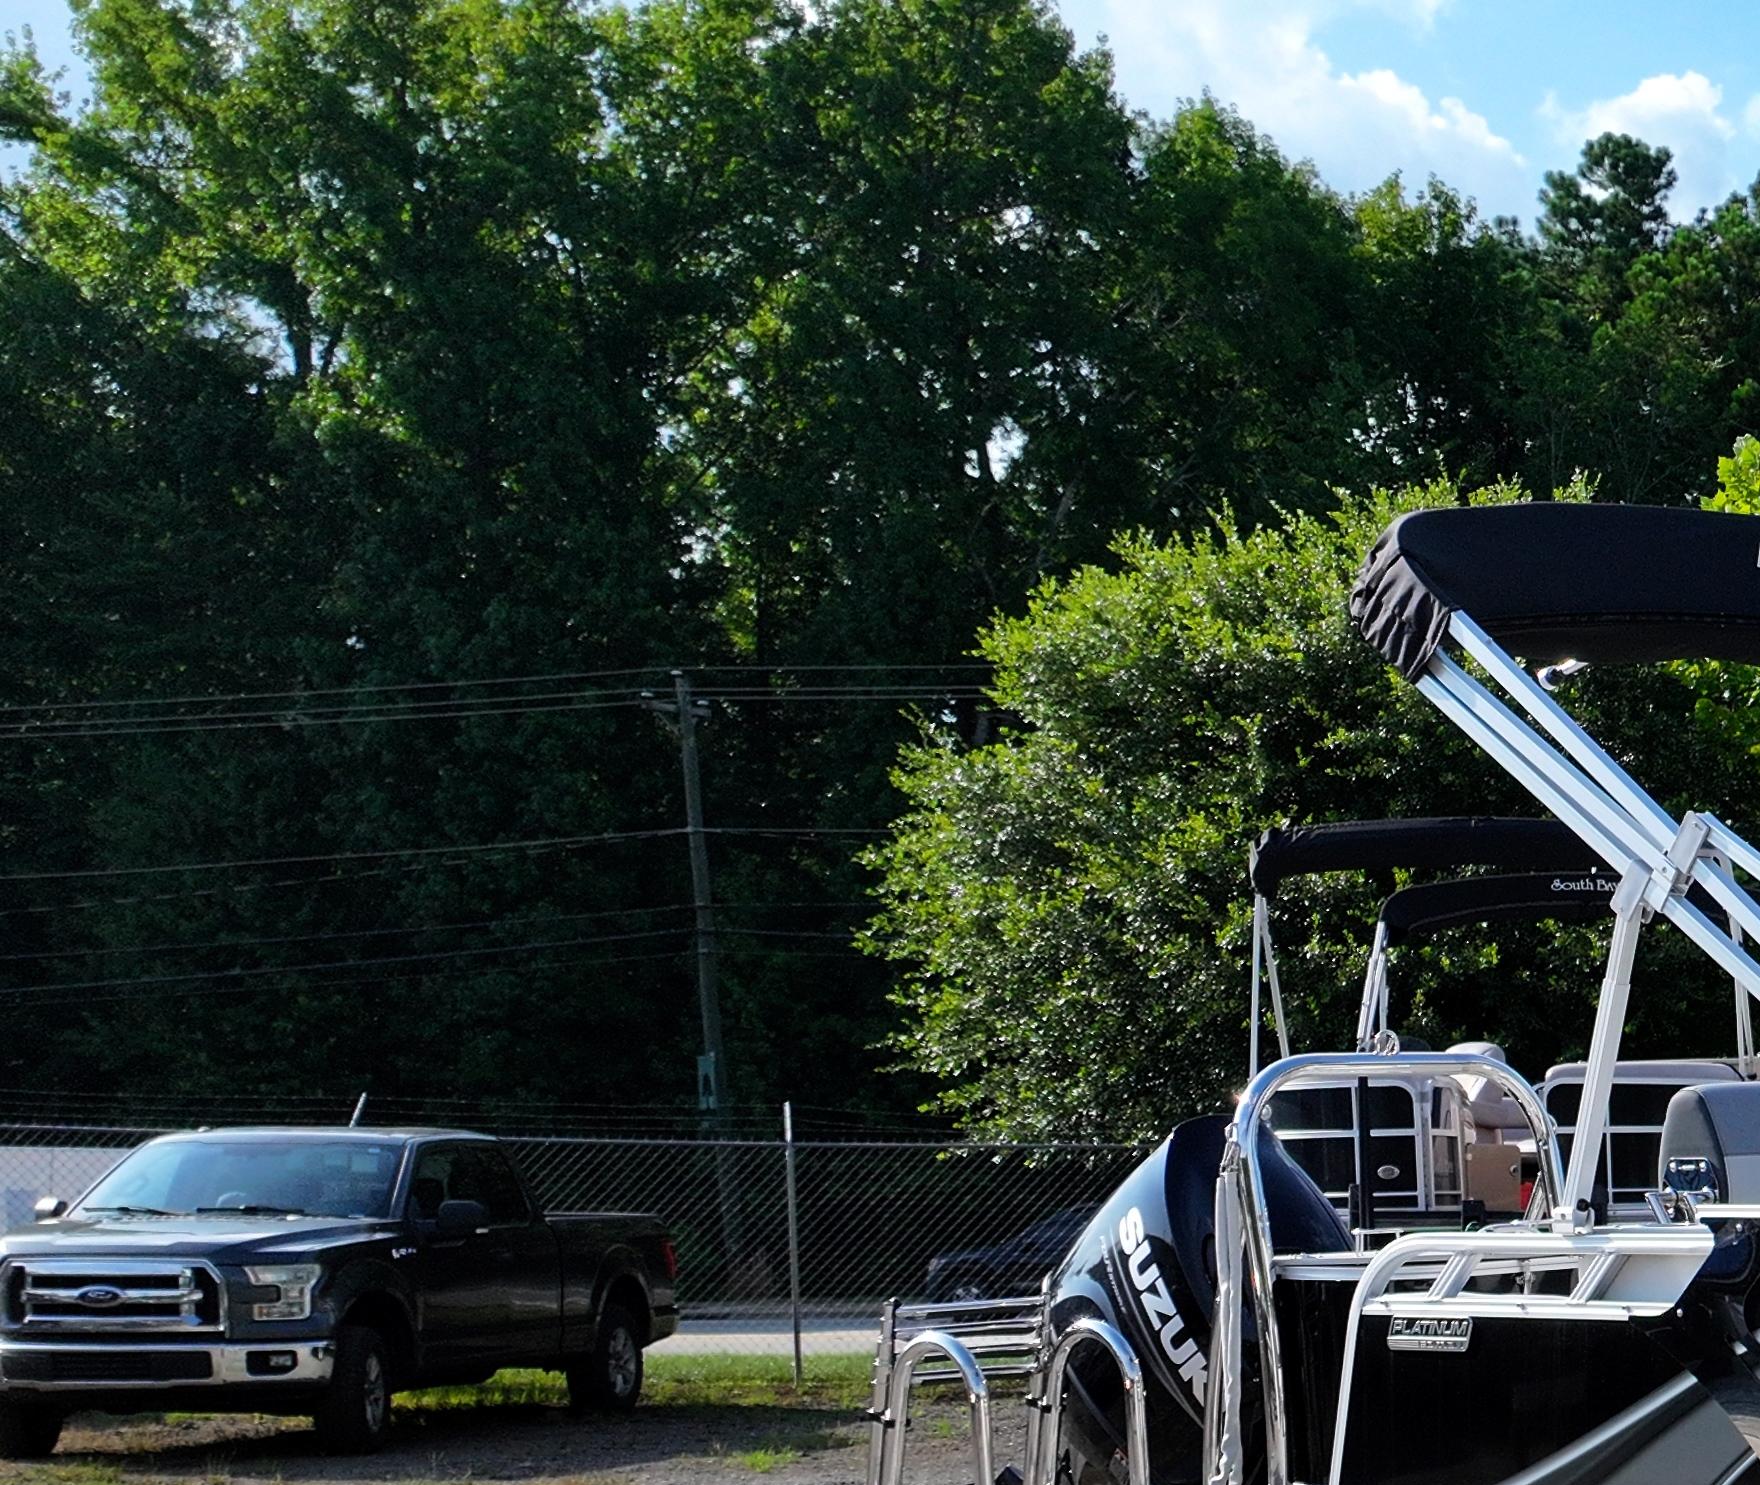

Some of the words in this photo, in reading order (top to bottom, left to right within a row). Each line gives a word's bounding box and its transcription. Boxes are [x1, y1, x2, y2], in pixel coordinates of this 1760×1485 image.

[1550, 878, 1594, 891] South
[1119, 1206, 1207, 1408] SUZUK
[1391, 1319, 1469, 1336] PLATINUM
